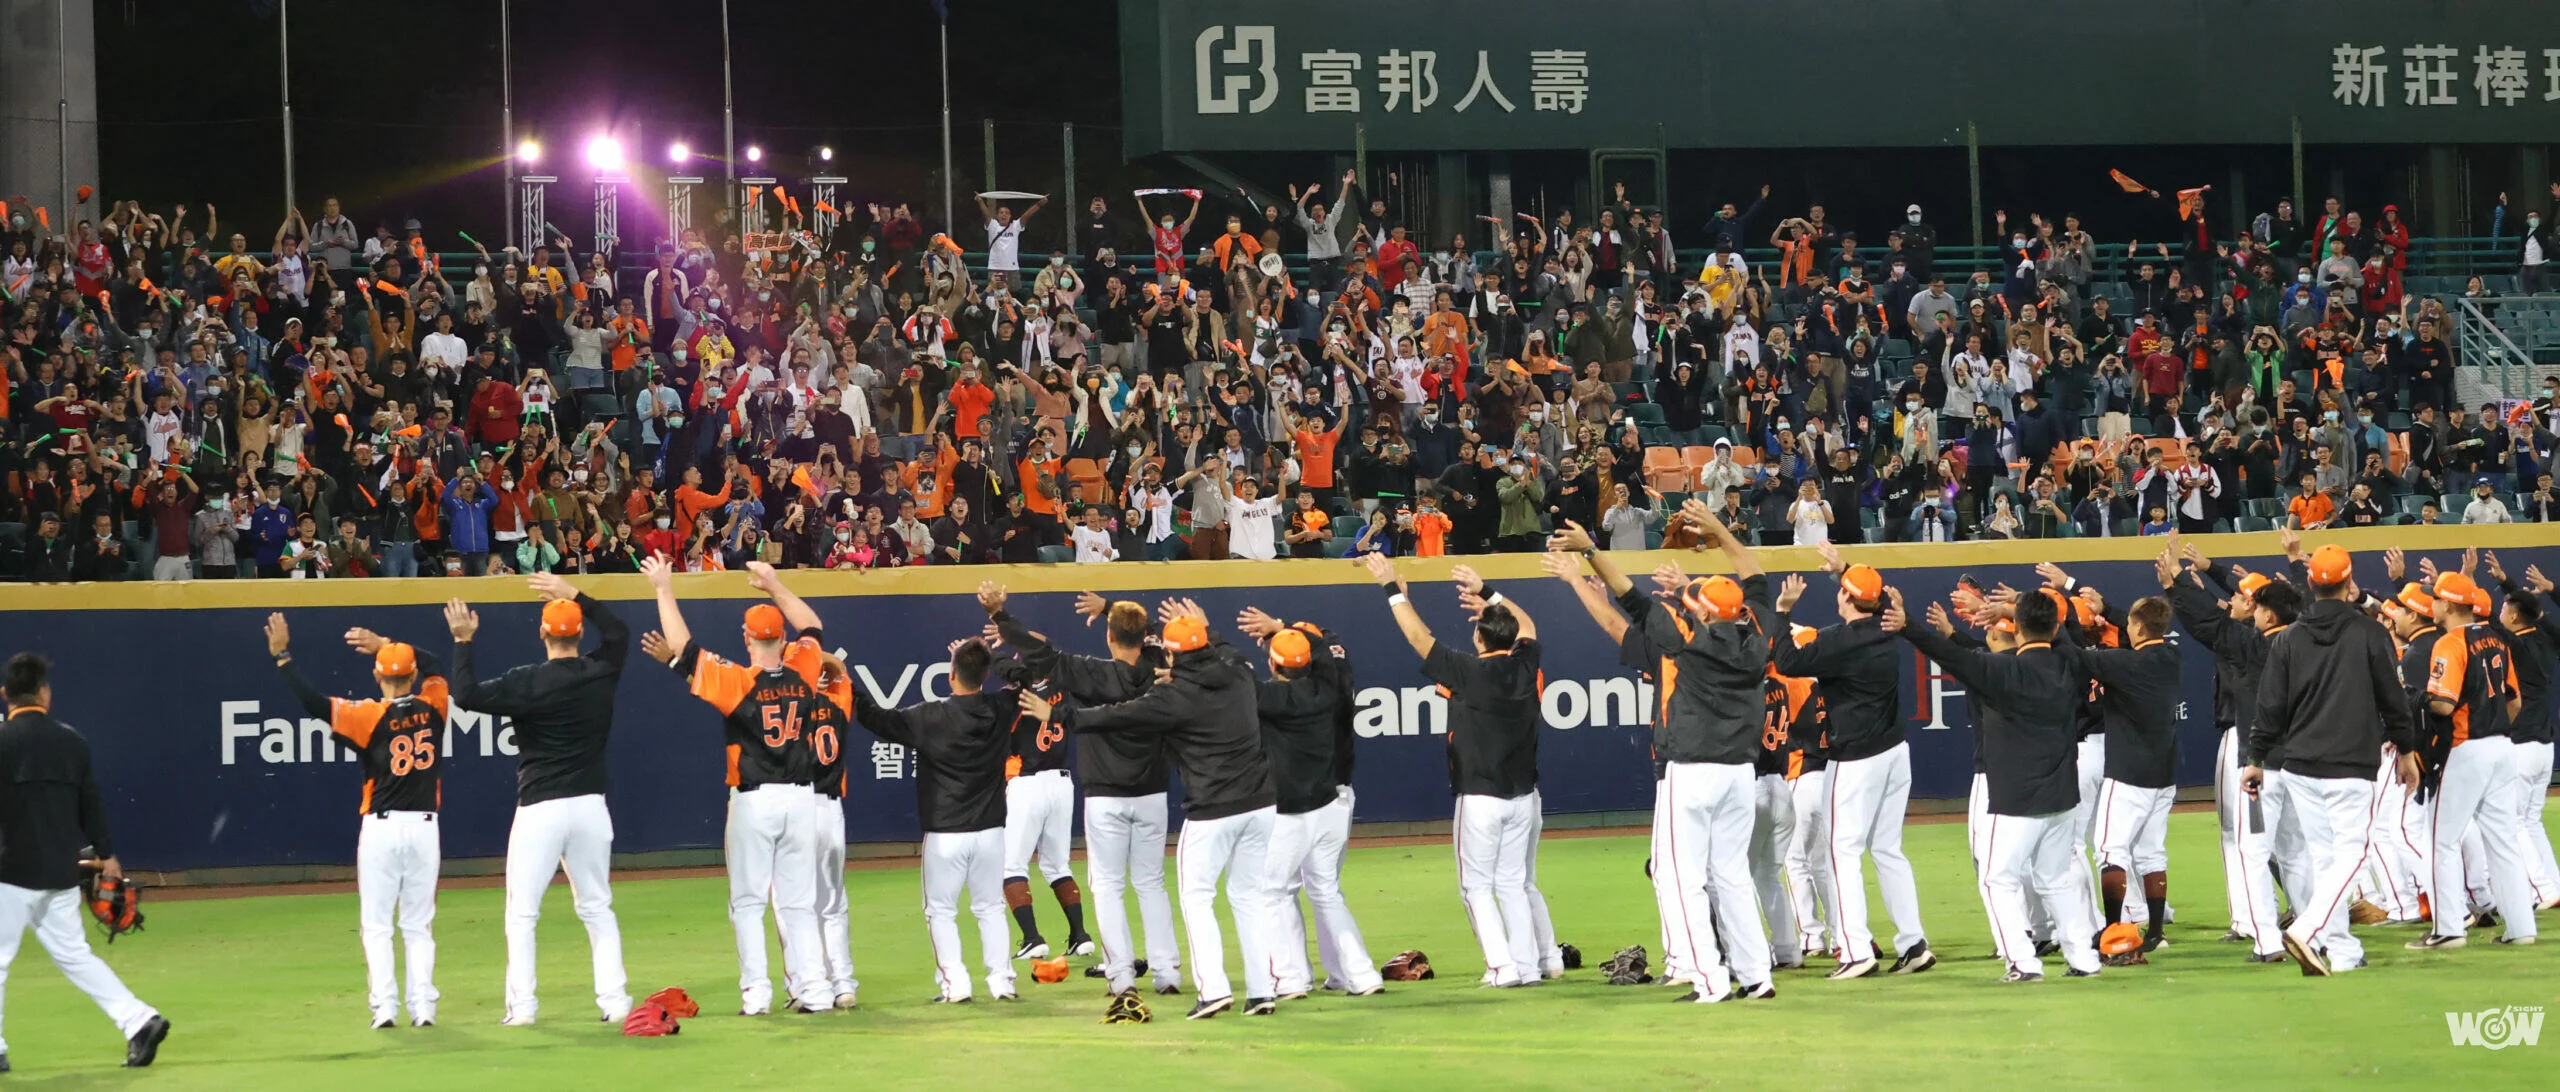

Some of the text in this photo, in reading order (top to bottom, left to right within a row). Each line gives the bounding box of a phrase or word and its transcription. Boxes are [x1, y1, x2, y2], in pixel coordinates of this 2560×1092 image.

[1301, 49, 1589, 114] 富邦人壽
[761, 700, 803, 748] 54
[389, 727, 435, 777] 85
